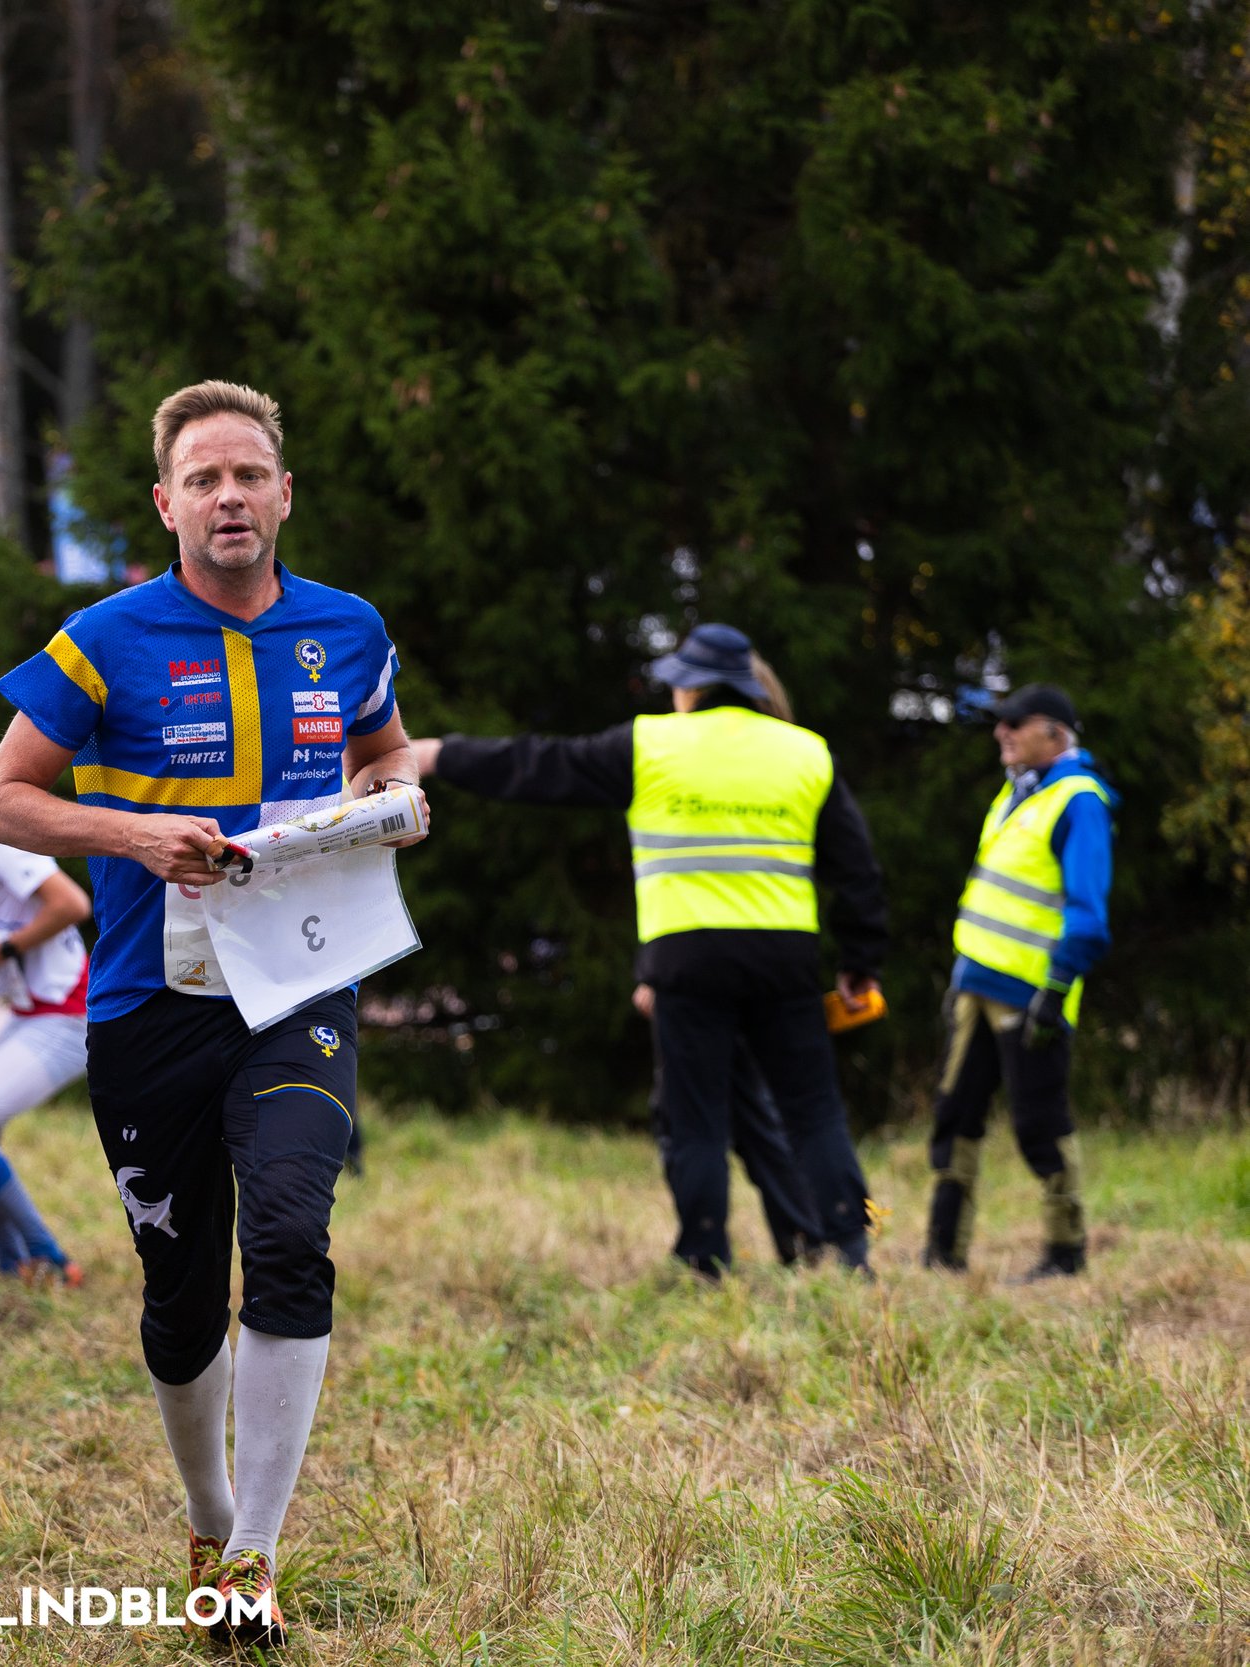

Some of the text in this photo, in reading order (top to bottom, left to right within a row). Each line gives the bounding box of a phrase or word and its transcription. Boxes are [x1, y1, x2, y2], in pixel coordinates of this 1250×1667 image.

[168, 660, 220, 677] MAXI
[184, 691, 222, 705] INTER
[185, 702, 221, 714] SPORT
[298, 720, 340, 734] MARELD
[170, 751, 226, 765] TRIMTEX
[301, 915, 326, 952] 3
